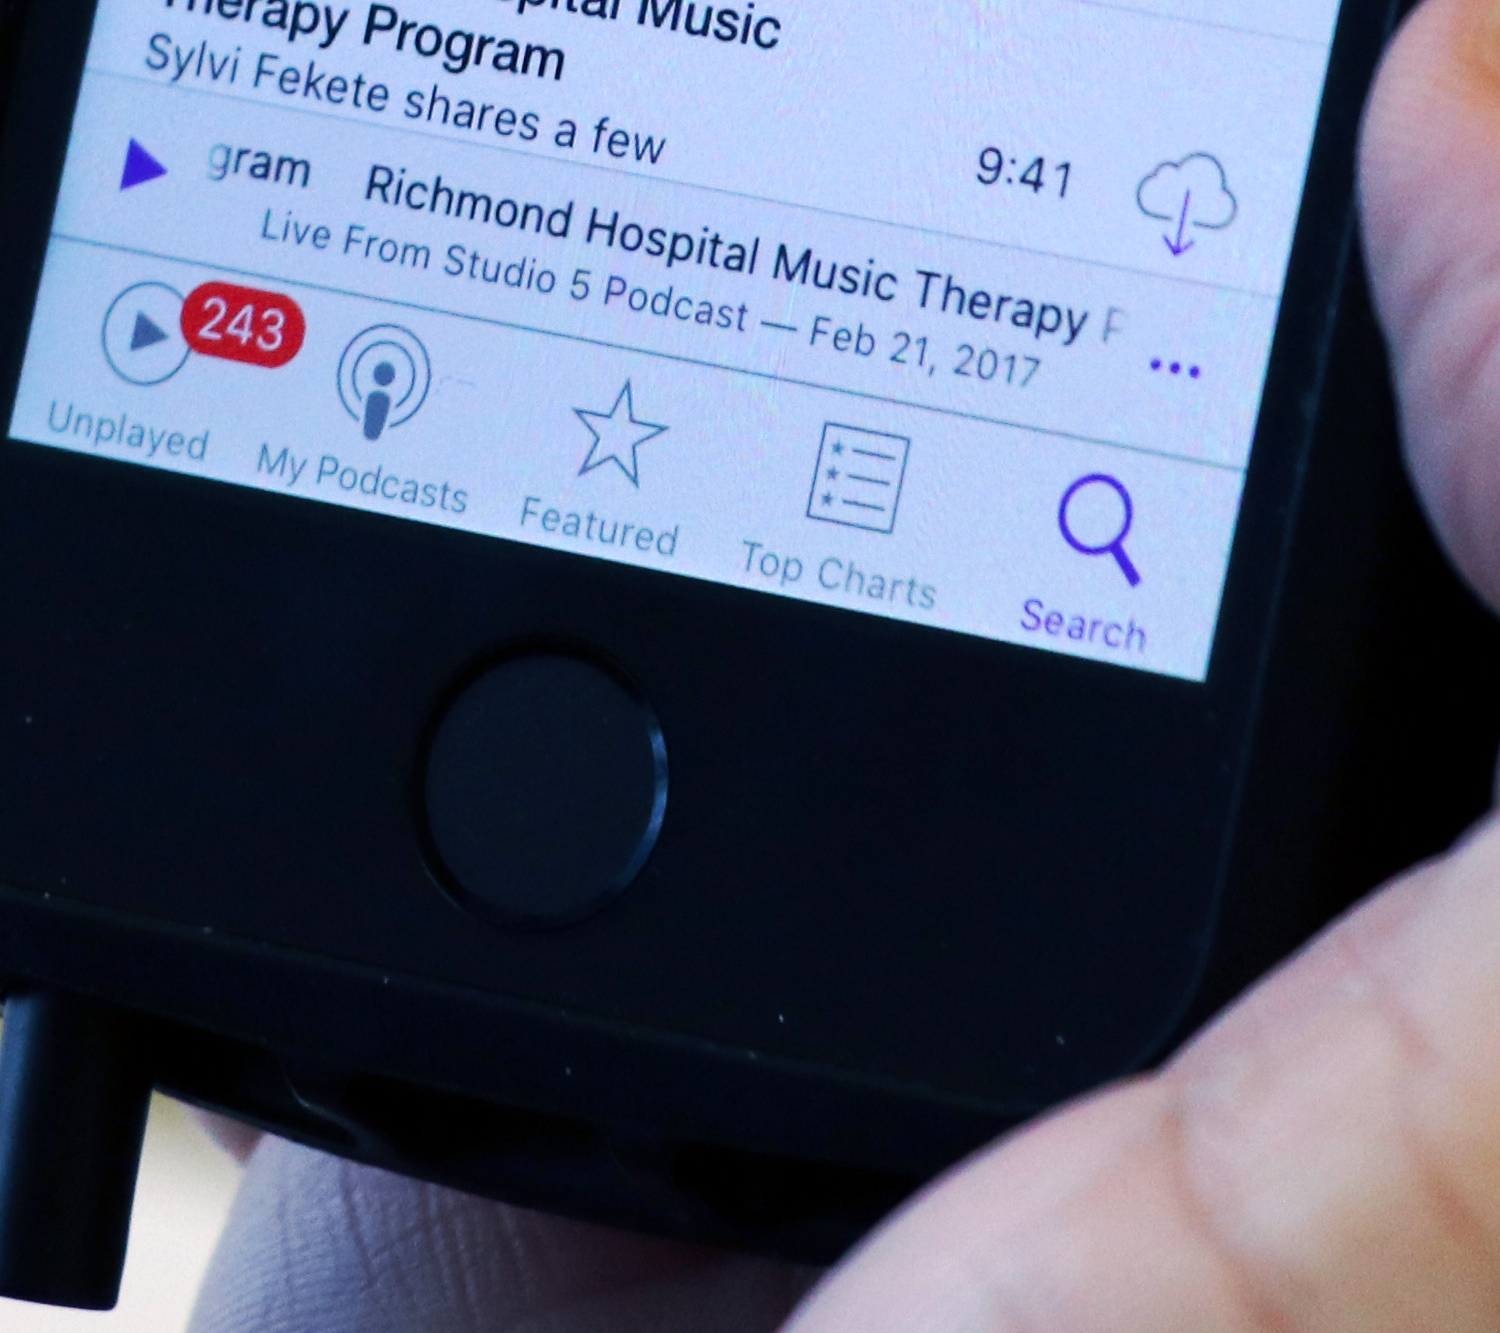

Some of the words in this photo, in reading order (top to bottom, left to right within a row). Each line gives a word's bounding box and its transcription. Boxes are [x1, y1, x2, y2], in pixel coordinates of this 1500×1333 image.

[361, 1, 566, 82] Program
[143, 31, 243, 85] Sylvi
[252, 51, 391, 114] Fekete
[403, 83, 541, 142] shares
[553, 118, 578, 150] a
[591, 115, 667, 166] few
[975, 145, 1072, 199] 9:41
[208, 142, 313, 190] gram
[364, 163, 575, 240] Richmond
[584, 205, 761, 276] Hospital
[771, 242, 899, 303] Music
[915, 268, 1090, 347] Therapy
[197, 295, 287, 353] 243
[259, 207, 333, 251] Live
[342, 222, 432, 271] From
[442, 243, 557, 295] Studio
[568, 267, 593, 303] 5
[602, 273, 749, 334] Podcast
[808, 314, 877, 358] Feb
[888, 329, 936, 378] 21,
[951, 342, 1043, 388] 2017
[46, 398, 211, 462] Unplayed
[256, 441, 309, 488] My
[315, 453, 469, 515] Podcasts
[519, 494, 681, 558] Featured
[741, 538, 805, 587] Top
[818, 555, 938, 611] Charts
[1019, 596, 1148, 652] Search
